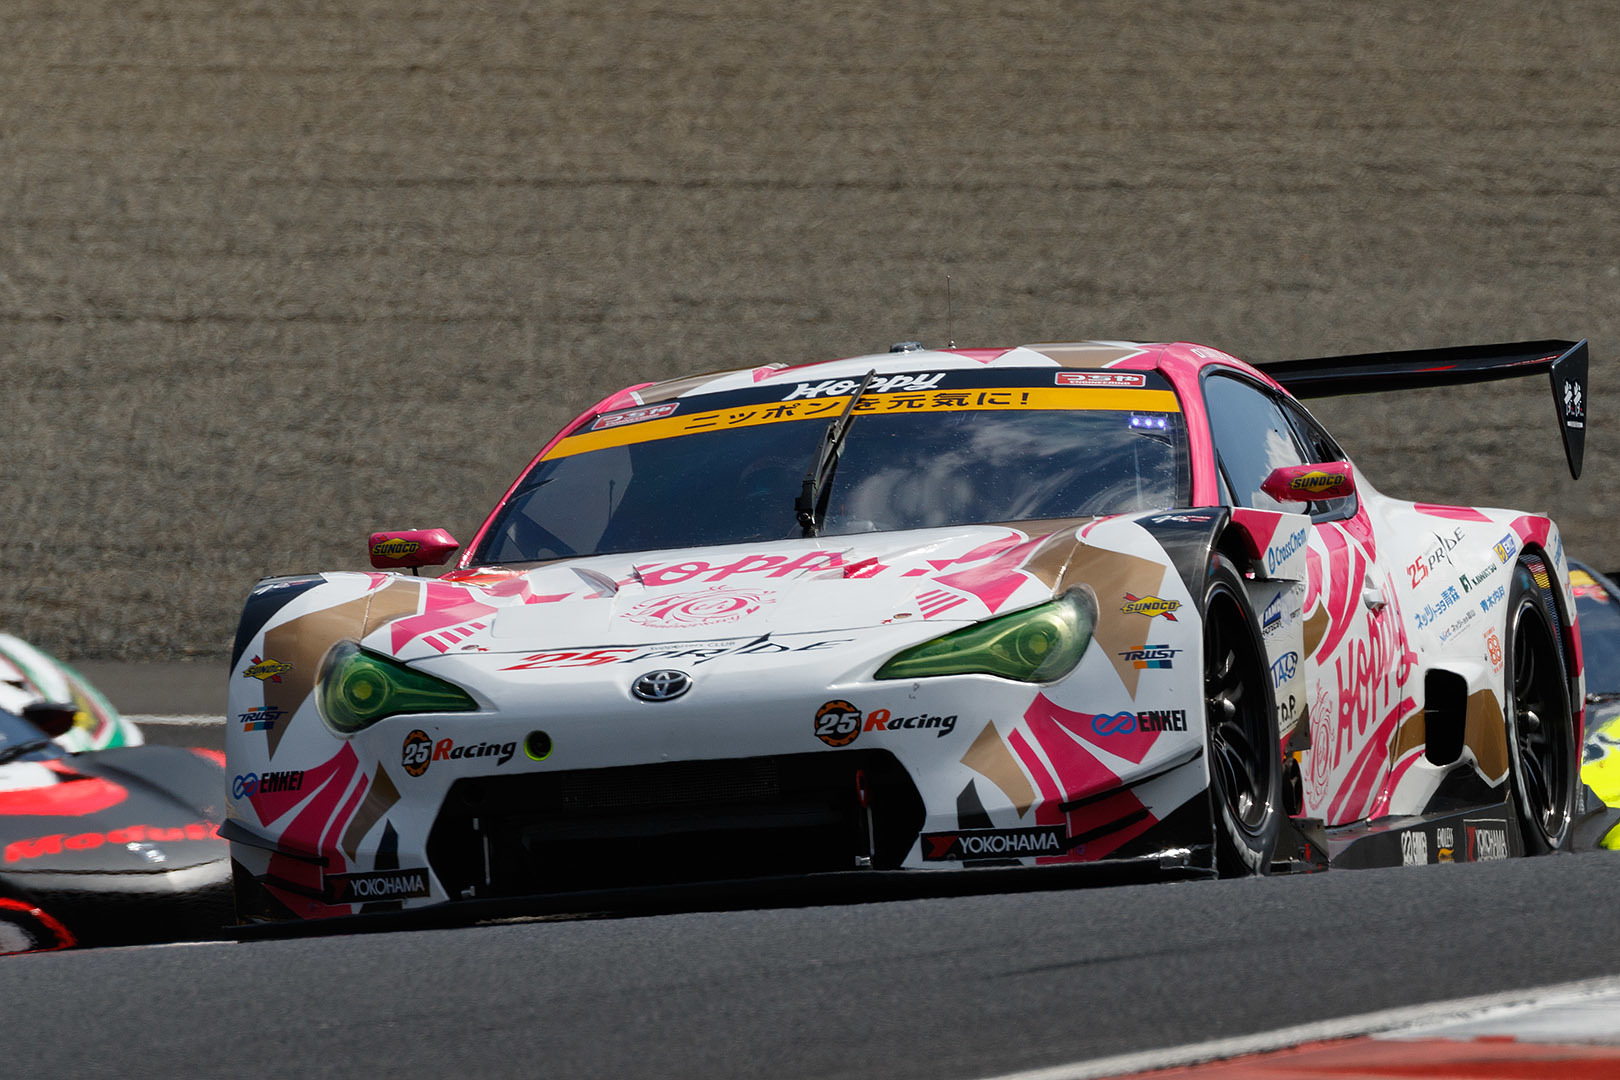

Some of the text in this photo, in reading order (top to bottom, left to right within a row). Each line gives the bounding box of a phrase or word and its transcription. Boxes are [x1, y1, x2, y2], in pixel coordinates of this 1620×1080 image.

[1293, 475, 1342, 488] SUNOCO
[374, 543, 417, 554] SUNOCO
[1275, 528, 1307, 566] CrossChem
[1407, 556, 1428, 589] 25
[1428, 527, 1465, 570] PRIDE
[1471, 563, 1498, 586] KAWATSU
[1126, 601, 1177, 612] SUNOCO
[497, 649, 638, 671] 25
[1118, 650, 1183, 661] TRUST
[247, 665, 288, 675] SUNOCO
[1333, 571, 1418, 771] Hoppy
[238, 711, 289, 723] TRUST
[816, 708, 958, 738] 25 Racing
[1137, 709, 1187, 732] ENKEI
[403, 738, 517, 766] 25 Racing
[260, 771, 304, 793] ENKEI
[958, 832, 1060, 854] YOKOHAMA
[351, 874, 424, 896] YOKOHAMA
